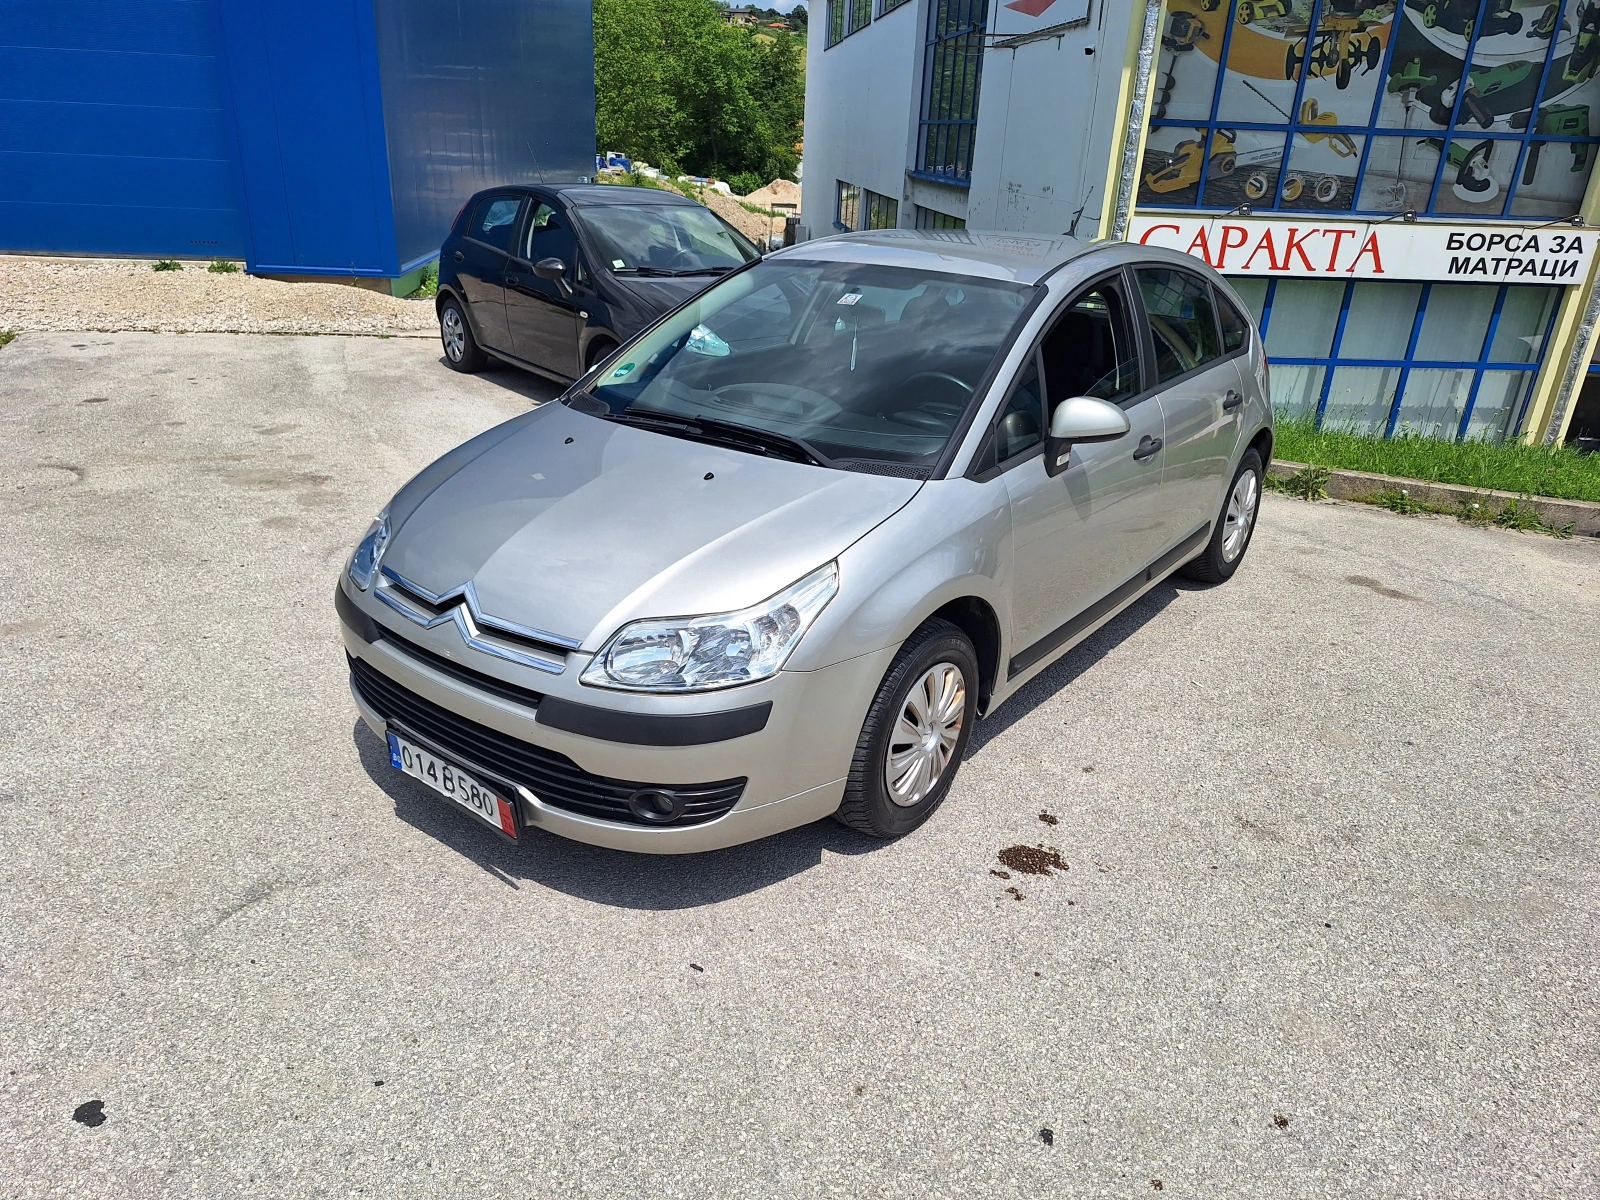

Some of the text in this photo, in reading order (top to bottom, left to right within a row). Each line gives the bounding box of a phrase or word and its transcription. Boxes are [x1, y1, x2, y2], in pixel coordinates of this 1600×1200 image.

[1445, 232, 1584, 254] БОРСА ЗА
[1447, 256, 1579, 281] МАТРАЦИ
